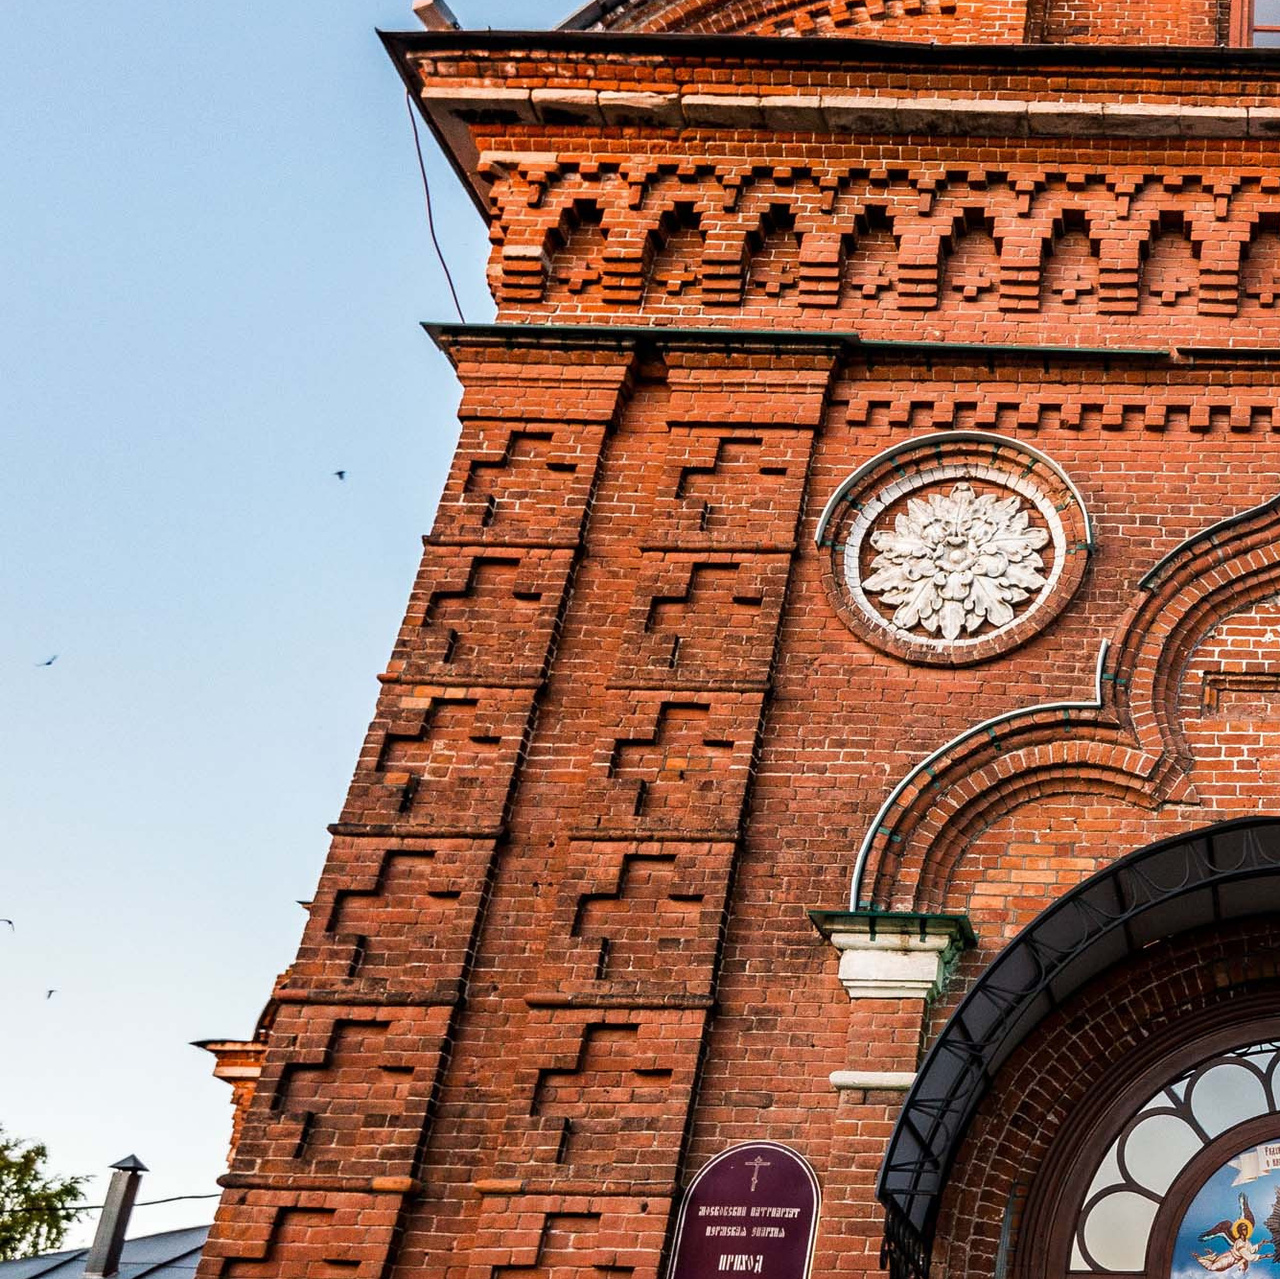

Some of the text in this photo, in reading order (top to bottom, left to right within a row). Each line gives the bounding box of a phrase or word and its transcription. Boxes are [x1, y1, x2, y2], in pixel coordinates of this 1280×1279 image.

[698, 1206, 801, 1218] МОСКОВСКИЙ ПАТРИАРХАТ
[705, 1226, 786, 1238] ПЕРМСКАЯ ЕПАРХИЯ
[718, 1254, 764, 1274] ПРИХОД
